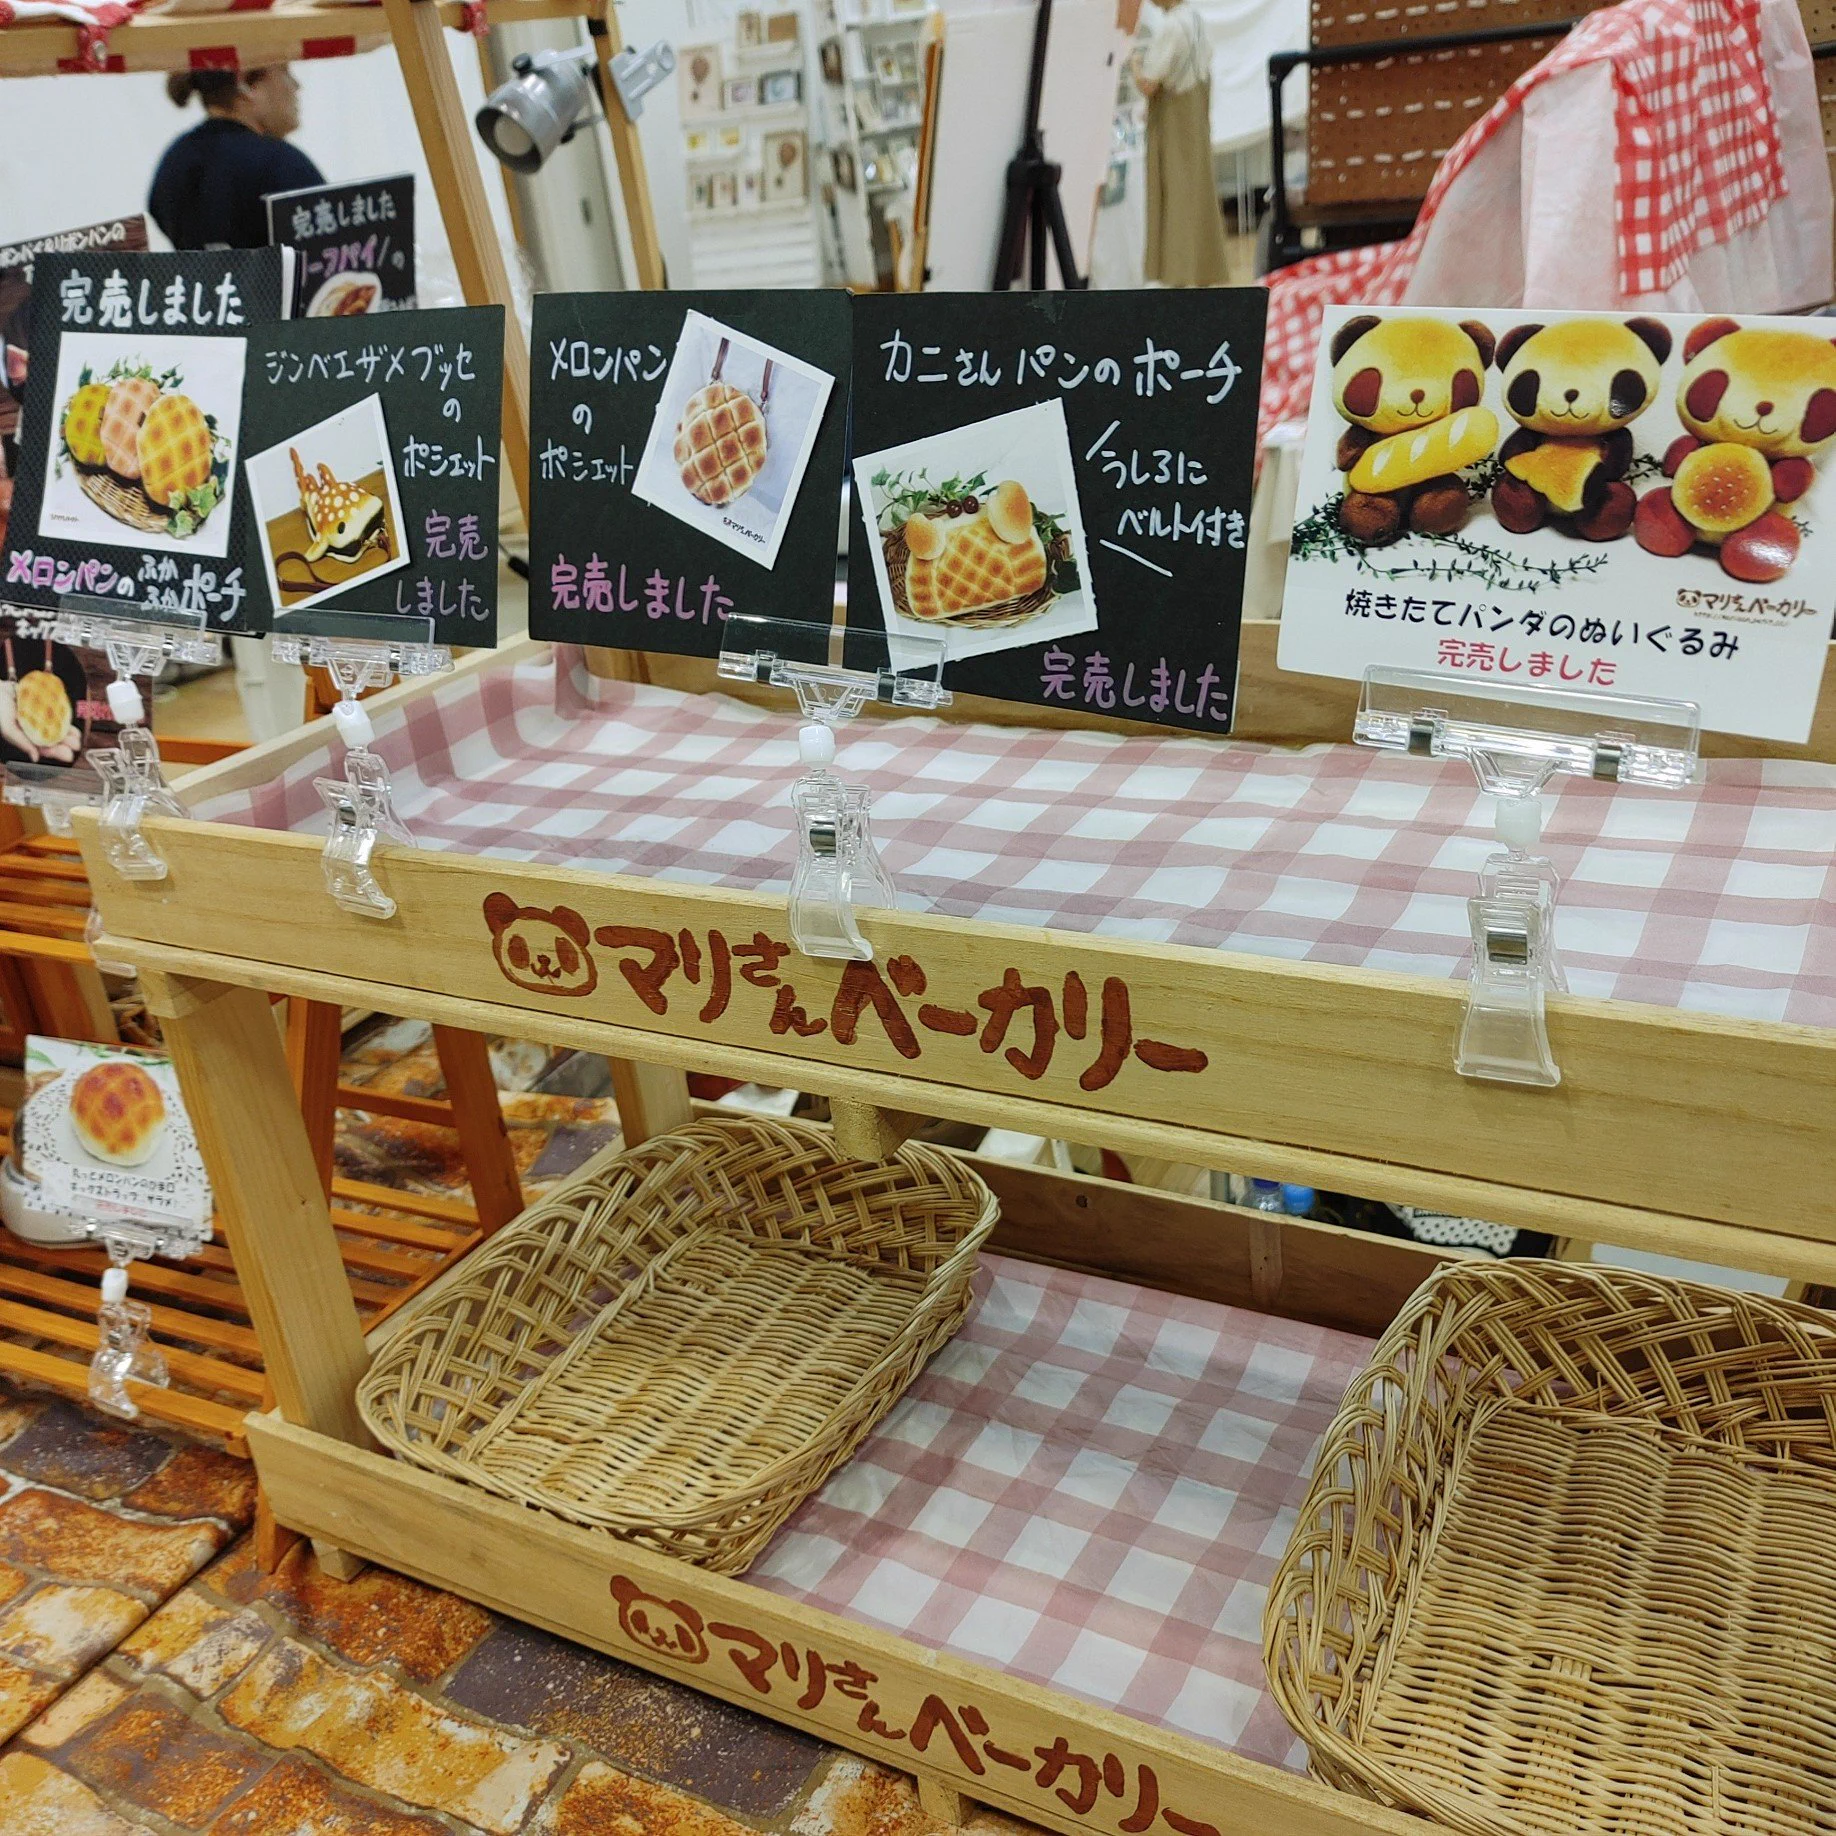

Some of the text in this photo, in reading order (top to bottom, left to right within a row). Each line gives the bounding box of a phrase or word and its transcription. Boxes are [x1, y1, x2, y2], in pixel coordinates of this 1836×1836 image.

[59, 268, 244, 328] 完売しました
[550, 337, 667, 384] メロンパン
[443, 398, 462, 423] の
[572, 404, 593, 434] の
[403, 435, 495, 481] ポシェット
[540, 438, 634, 485] ポシェット
[1102, 450, 1208, 489] うしろに
[425, 509, 488, 561] 完売
[1118, 502, 1245, 549] ベルト付き
[396, 576, 489, 621] しました
[551, 552, 735, 625] 完売しました
[1346, 589, 1739, 661] 焼きたてパンダのぬいぐるみ
[1040, 645, 1228, 721] 完売しました
[1437, 638, 1617, 687] 完売しました
[595, 925, 1209, 1091] マリさんベーカリー
[707, 1621, 1220, 1836] マリさんベーカリー
